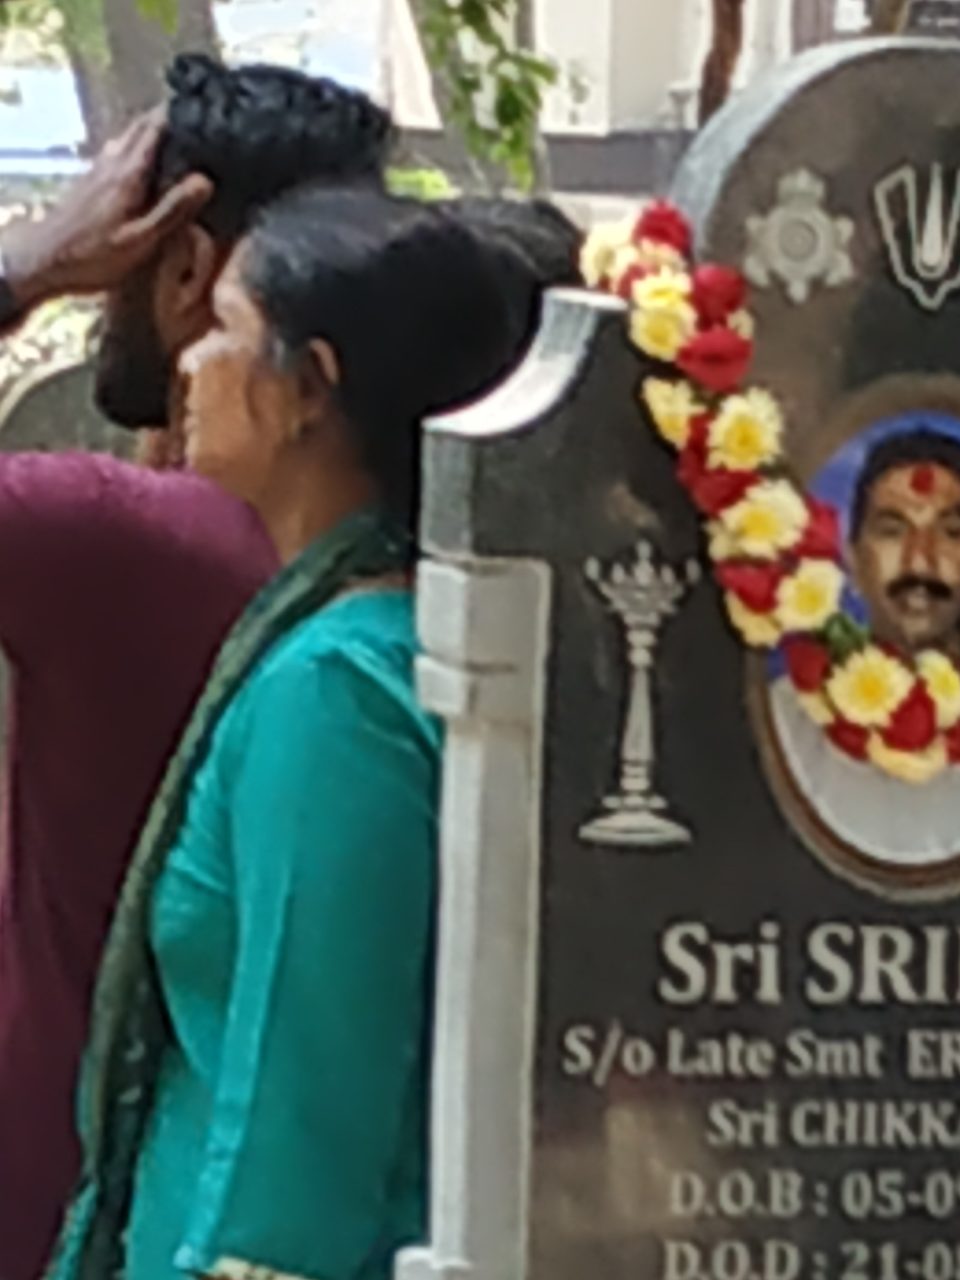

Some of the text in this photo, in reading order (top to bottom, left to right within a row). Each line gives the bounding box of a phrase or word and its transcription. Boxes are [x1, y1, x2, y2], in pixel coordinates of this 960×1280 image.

[660, 922, 781, 1003] Sri
[562, 1019, 655, 1087] S/o
[667, 1030, 775, 1077] Late
[784, 1028, 884, 1078] Smt
[706, 1099, 778, 1147] Sri
